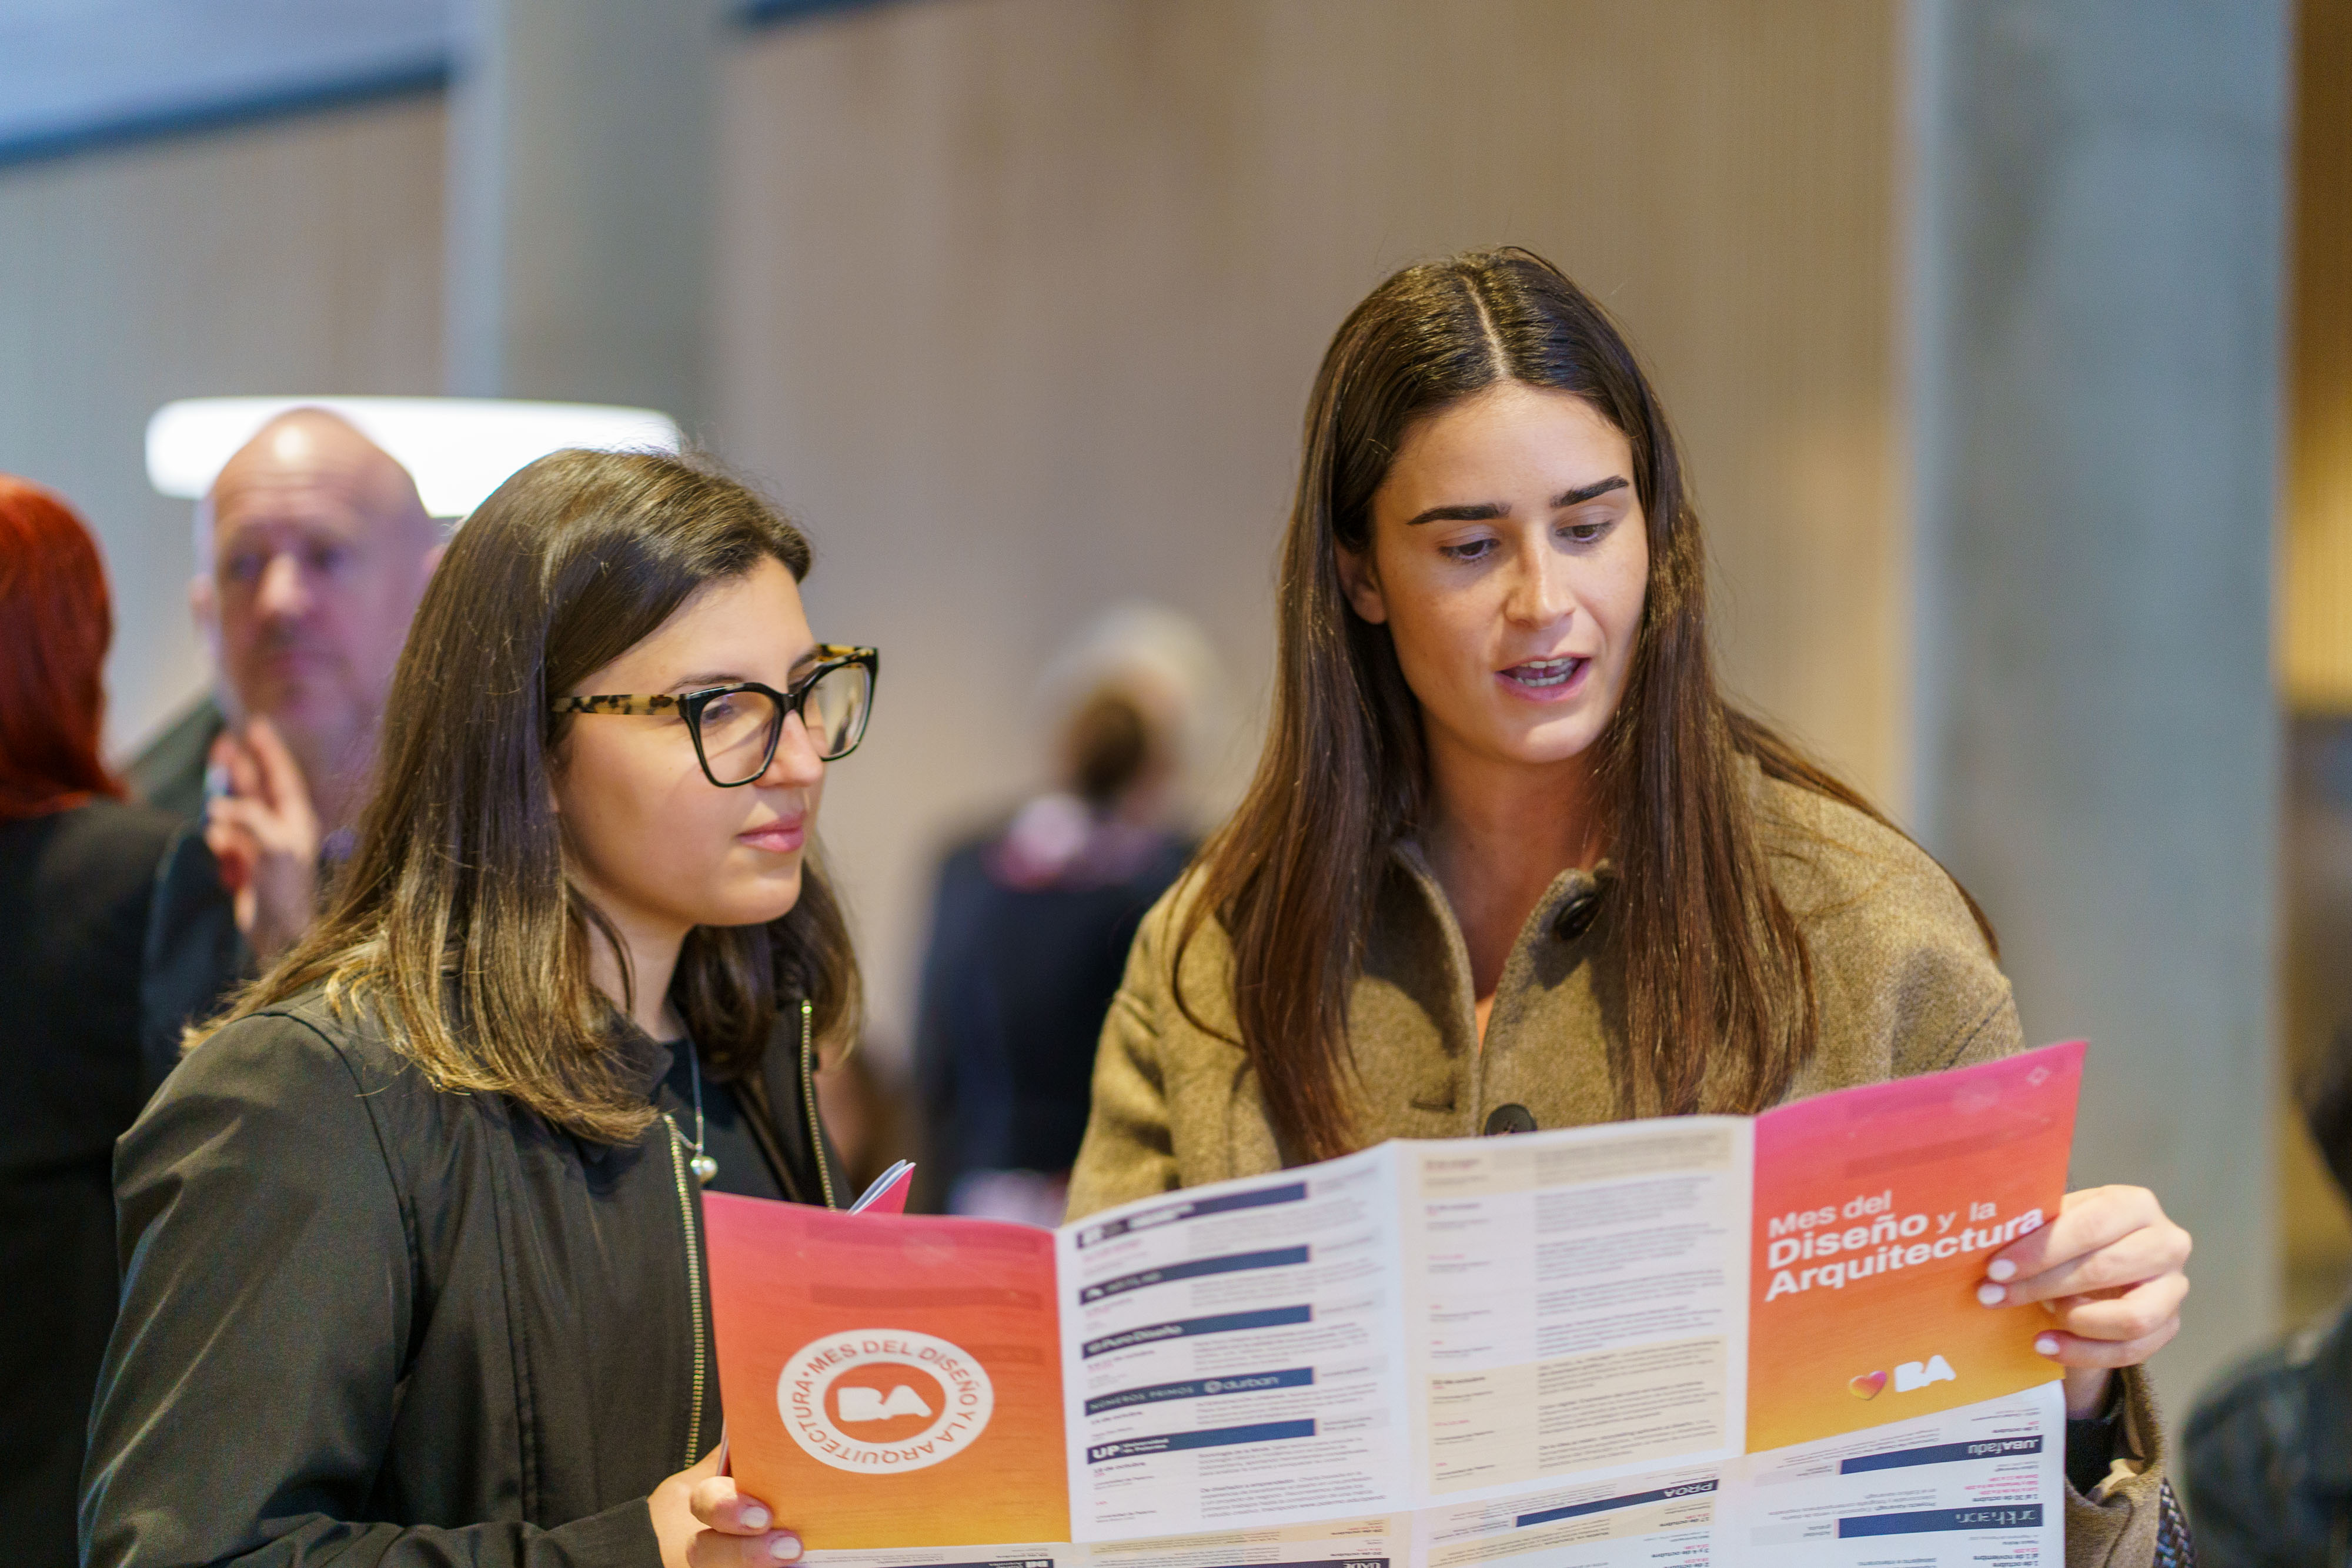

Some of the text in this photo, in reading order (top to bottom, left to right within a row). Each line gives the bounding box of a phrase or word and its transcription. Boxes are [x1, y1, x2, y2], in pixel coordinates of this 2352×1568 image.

[1768, 1201, 1996, 1270] Diseño y la
[1769, 1189, 1892, 1238] Mes del
[1765, 1208, 2044, 1303] Arquitectura
[791, 1339, 981, 1465] MES DEL DISEÑO Y LA ARQUITECTURA
[1092, 1445, 1120, 1459] UP
[1663, 1482, 1713, 1497] PROA
